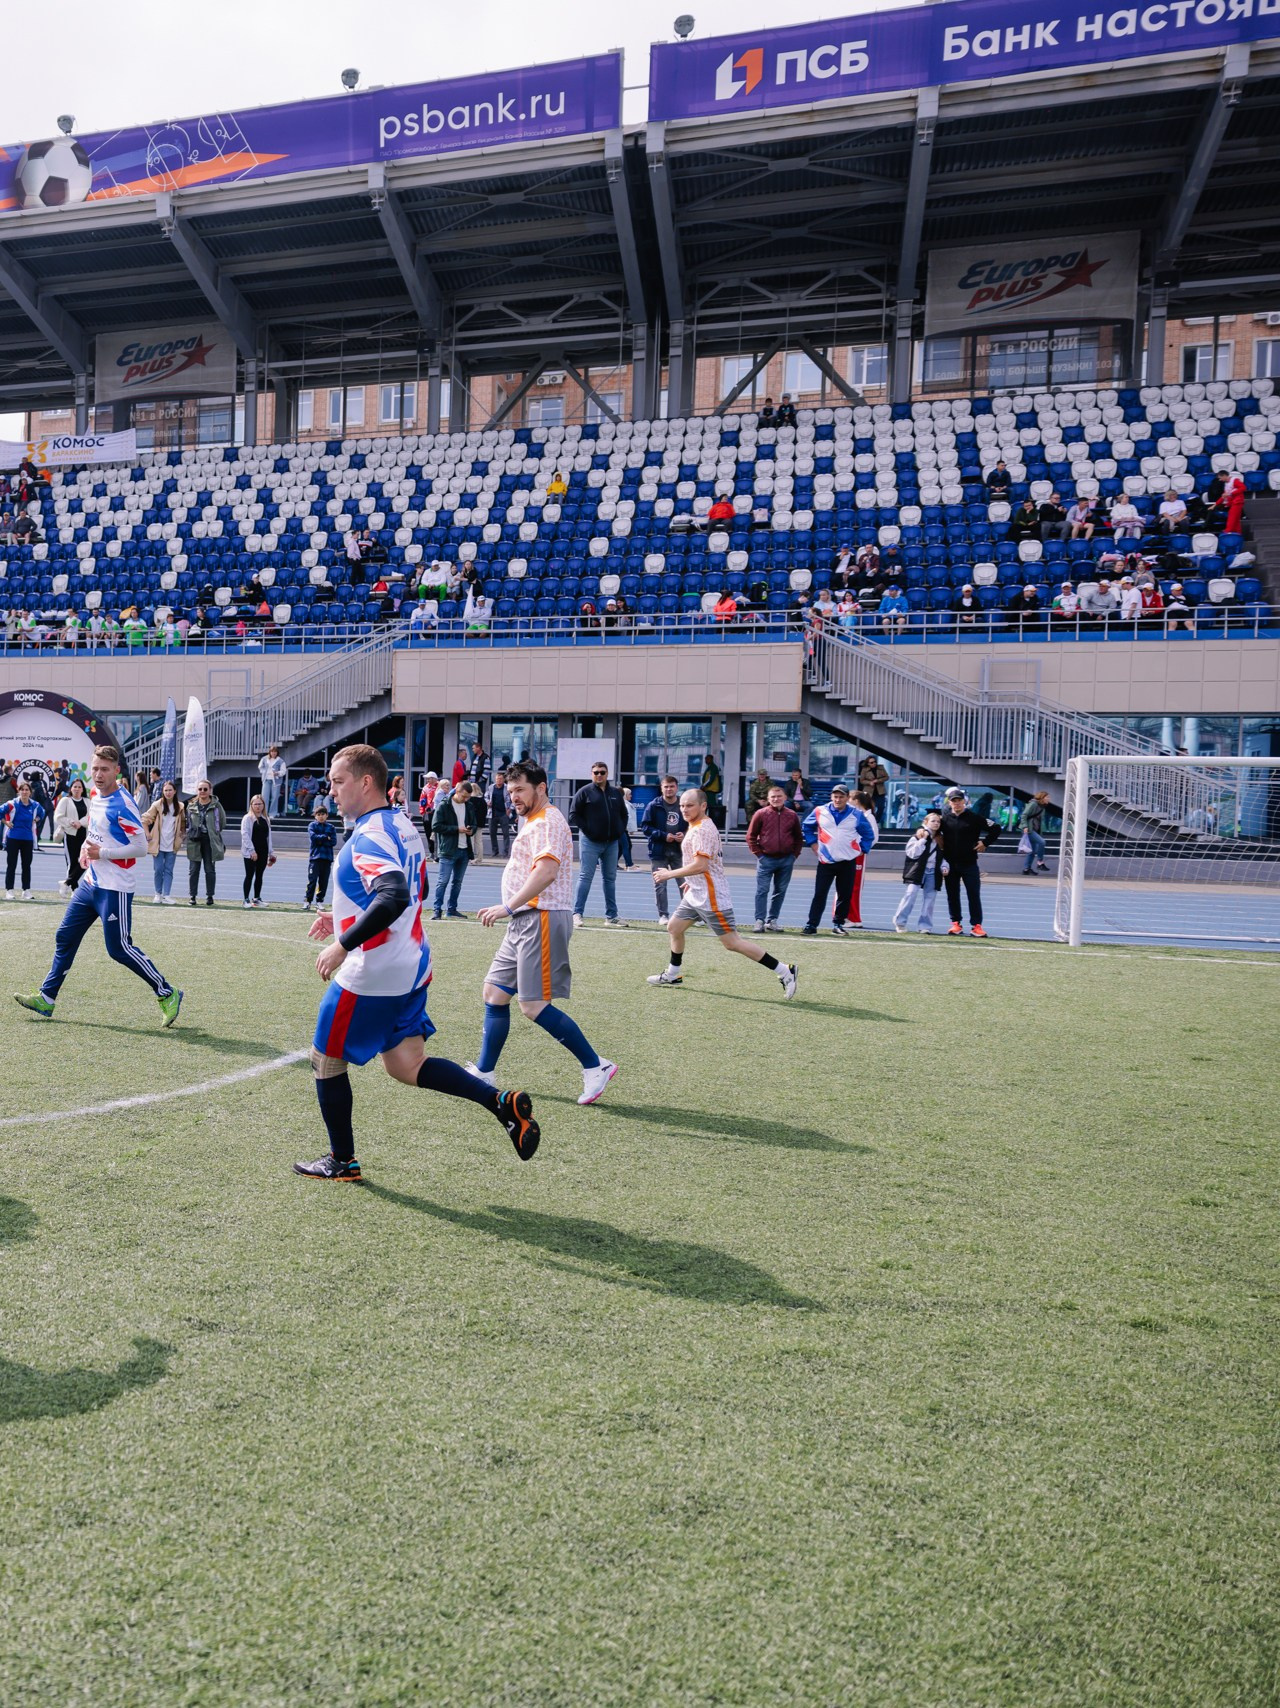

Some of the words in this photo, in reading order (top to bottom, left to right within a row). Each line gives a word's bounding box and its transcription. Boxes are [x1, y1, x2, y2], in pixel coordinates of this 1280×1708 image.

[942, 19, 1060, 61] Банк
[775, 39, 869, 85] ПСБ
[379, 91, 565, 148] psbank.ru
[957, 251, 1082, 290] Europa
[116, 336, 198, 367] Europa
[1020, 337, 1078, 353] РОССИИ
[52, 437, 105, 449] КОМОС
[13, 693, 44, 702] КОМОС
